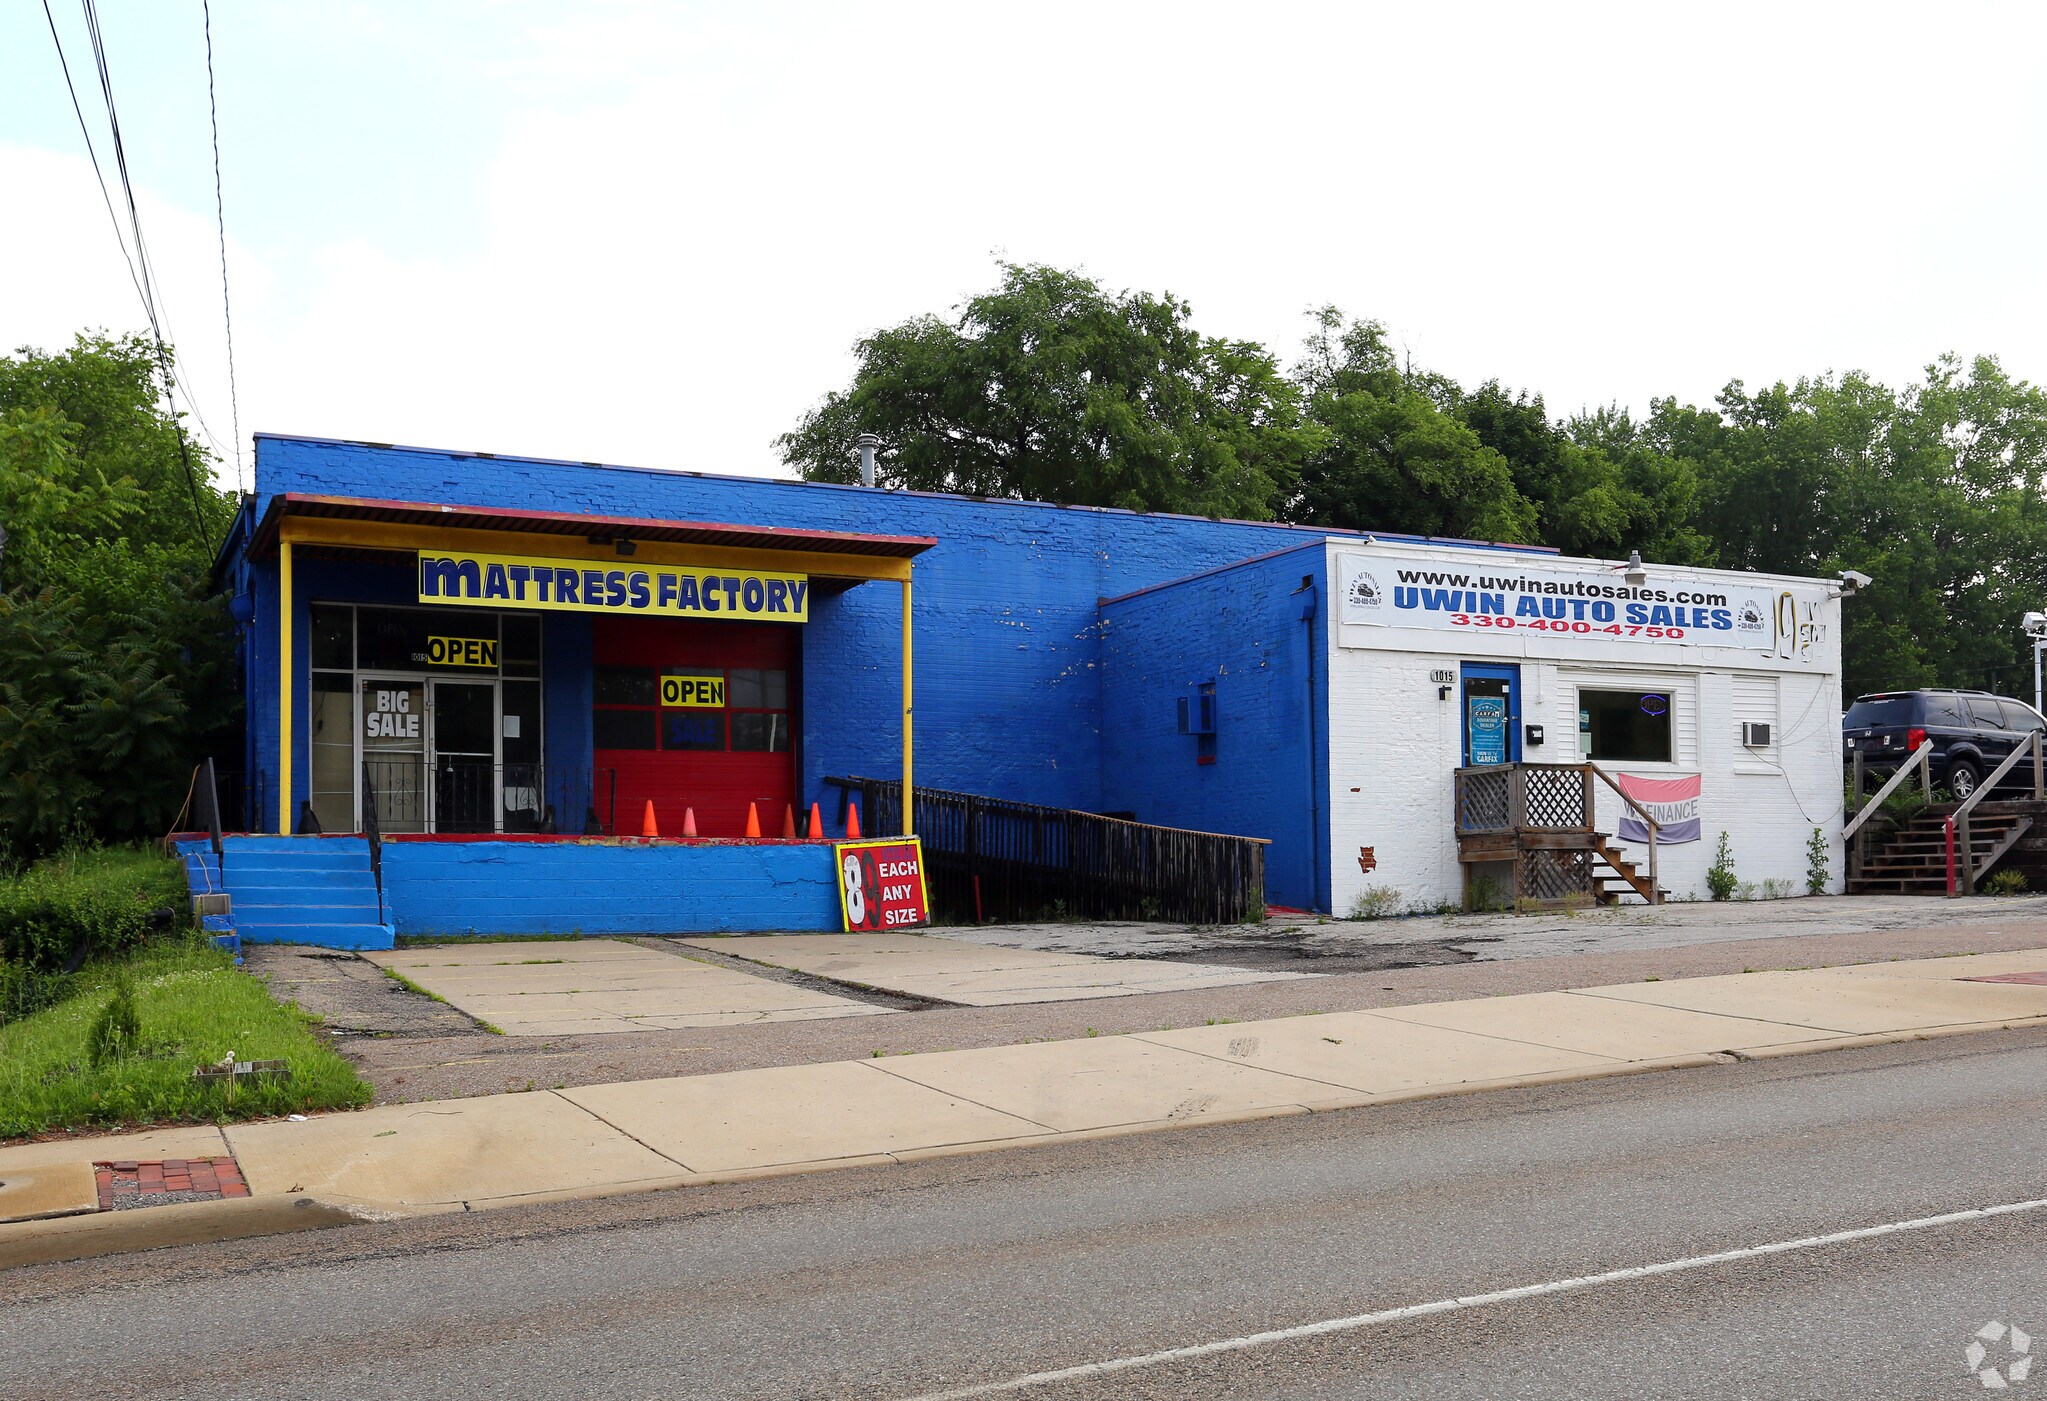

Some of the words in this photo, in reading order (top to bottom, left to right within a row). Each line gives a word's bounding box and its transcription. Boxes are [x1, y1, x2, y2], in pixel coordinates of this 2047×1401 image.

[656, 573, 809, 614] FACTORY
[1396, 569, 1727, 606] www.uwinautosales.com
[1393, 585, 1505, 616] UWIN
[1515, 595, 1615, 623] AUTO
[1626, 603, 1733, 631] SALES
[1450, 613, 1685, 639] 330-400-4750
[428, 637, 497, 666] OPEN
[1435, 670, 1453, 681] 1015
[376, 690, 409, 713] BIG
[663, 679, 724, 704] OPEN
[367, 712, 419, 737] SALE
[672, 719, 717, 744] SALE
[1646, 799, 1698, 822] FINANCE
[879, 860, 919, 878] EACH
[843, 849, 881, 928] 89
[883, 884, 912, 902] ANY
[885, 908, 918, 925] SIZE
